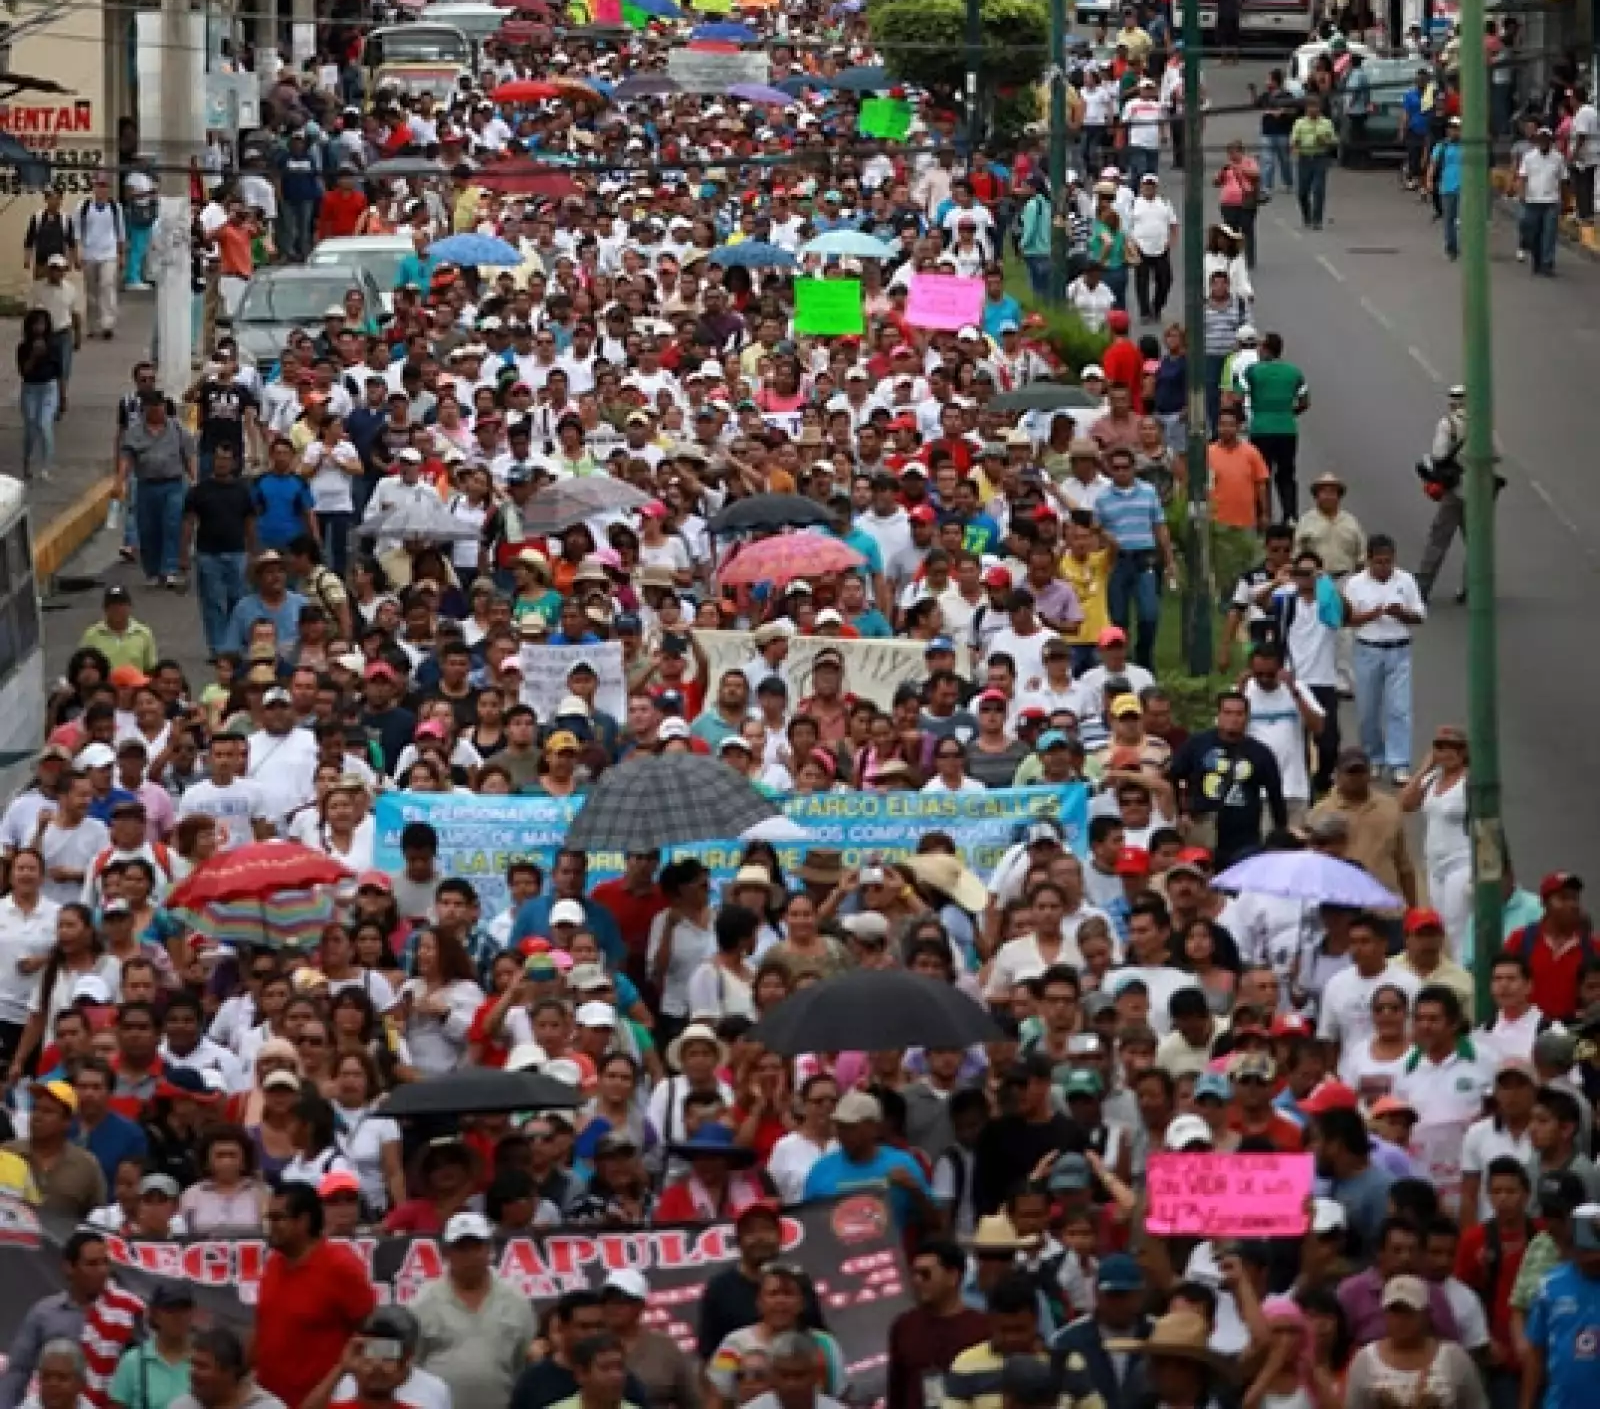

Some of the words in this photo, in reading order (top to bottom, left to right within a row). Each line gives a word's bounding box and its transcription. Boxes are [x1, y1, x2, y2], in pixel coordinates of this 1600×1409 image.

[887, 795, 957, 818] ELIAS
[105, 1234, 378, 1284] REGIN
[397, 1216, 805, 1283] AAPULCO
